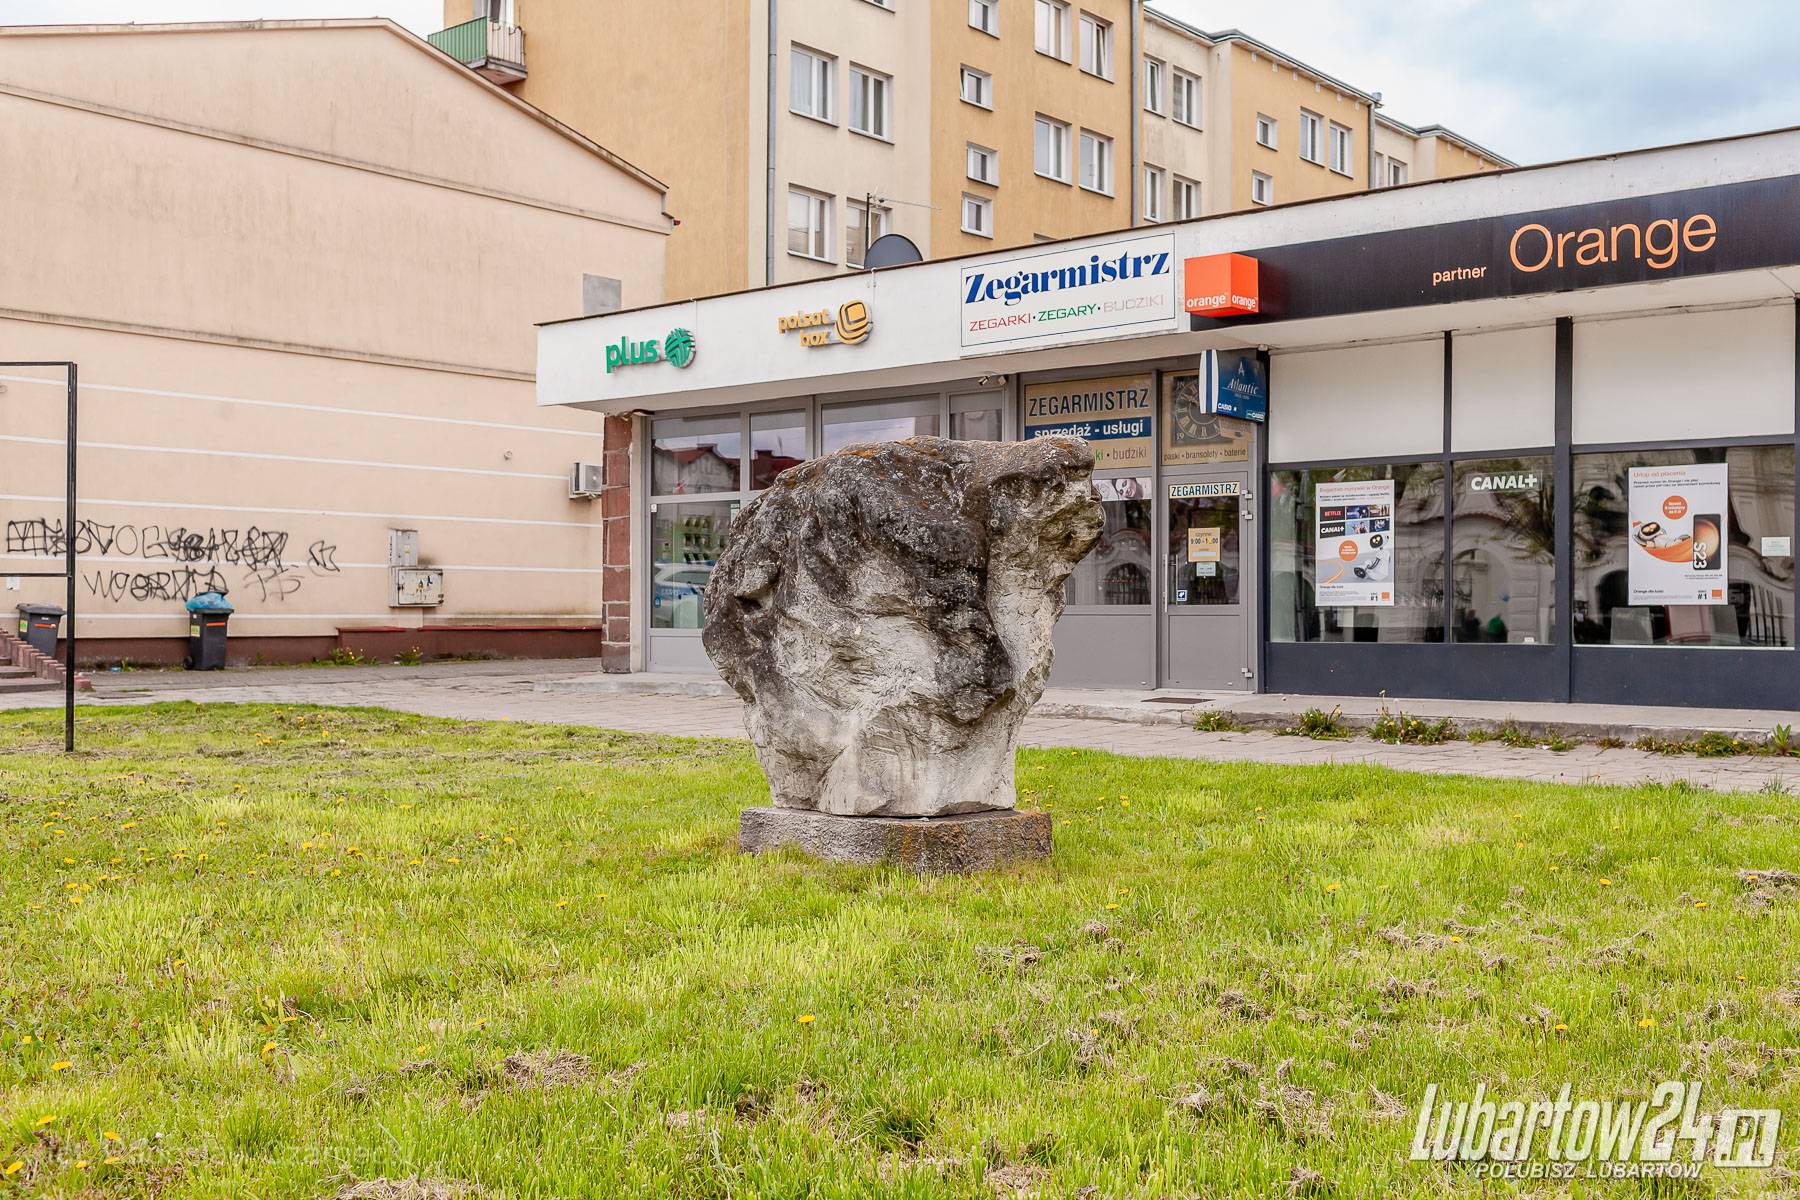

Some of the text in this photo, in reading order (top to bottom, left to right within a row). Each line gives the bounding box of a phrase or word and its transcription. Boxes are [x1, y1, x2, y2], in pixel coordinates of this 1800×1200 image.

[1510, 213, 1717, 272] Orange
[965, 250, 1170, 306] Zegarmistrz
[1432, 264, 1487, 286] partner
[1187, 294, 1226, 308] orange
[1231, 294, 1256, 309] orange
[778, 309, 830, 334] polsat
[969, 313, 1031, 332] ZEGARKI
[1038, 304, 1097, 322] ZEGARY
[800, 330, 831, 347] box
[605, 336, 660, 373] plus
[1227, 378, 1259, 395] Atlantic
[1029, 388, 1149, 417] ZEGARMISTRZ
[1103, 419, 1144, 436] usługi
[1112, 447, 1147, 460] budziki
[1223, 447, 1247, 457] baterie
[1171, 483, 1238, 497] ZEGARMISTRZ
[1470, 473, 1538, 490] CANAL+
[1693, 542, 1708, 569] S23
